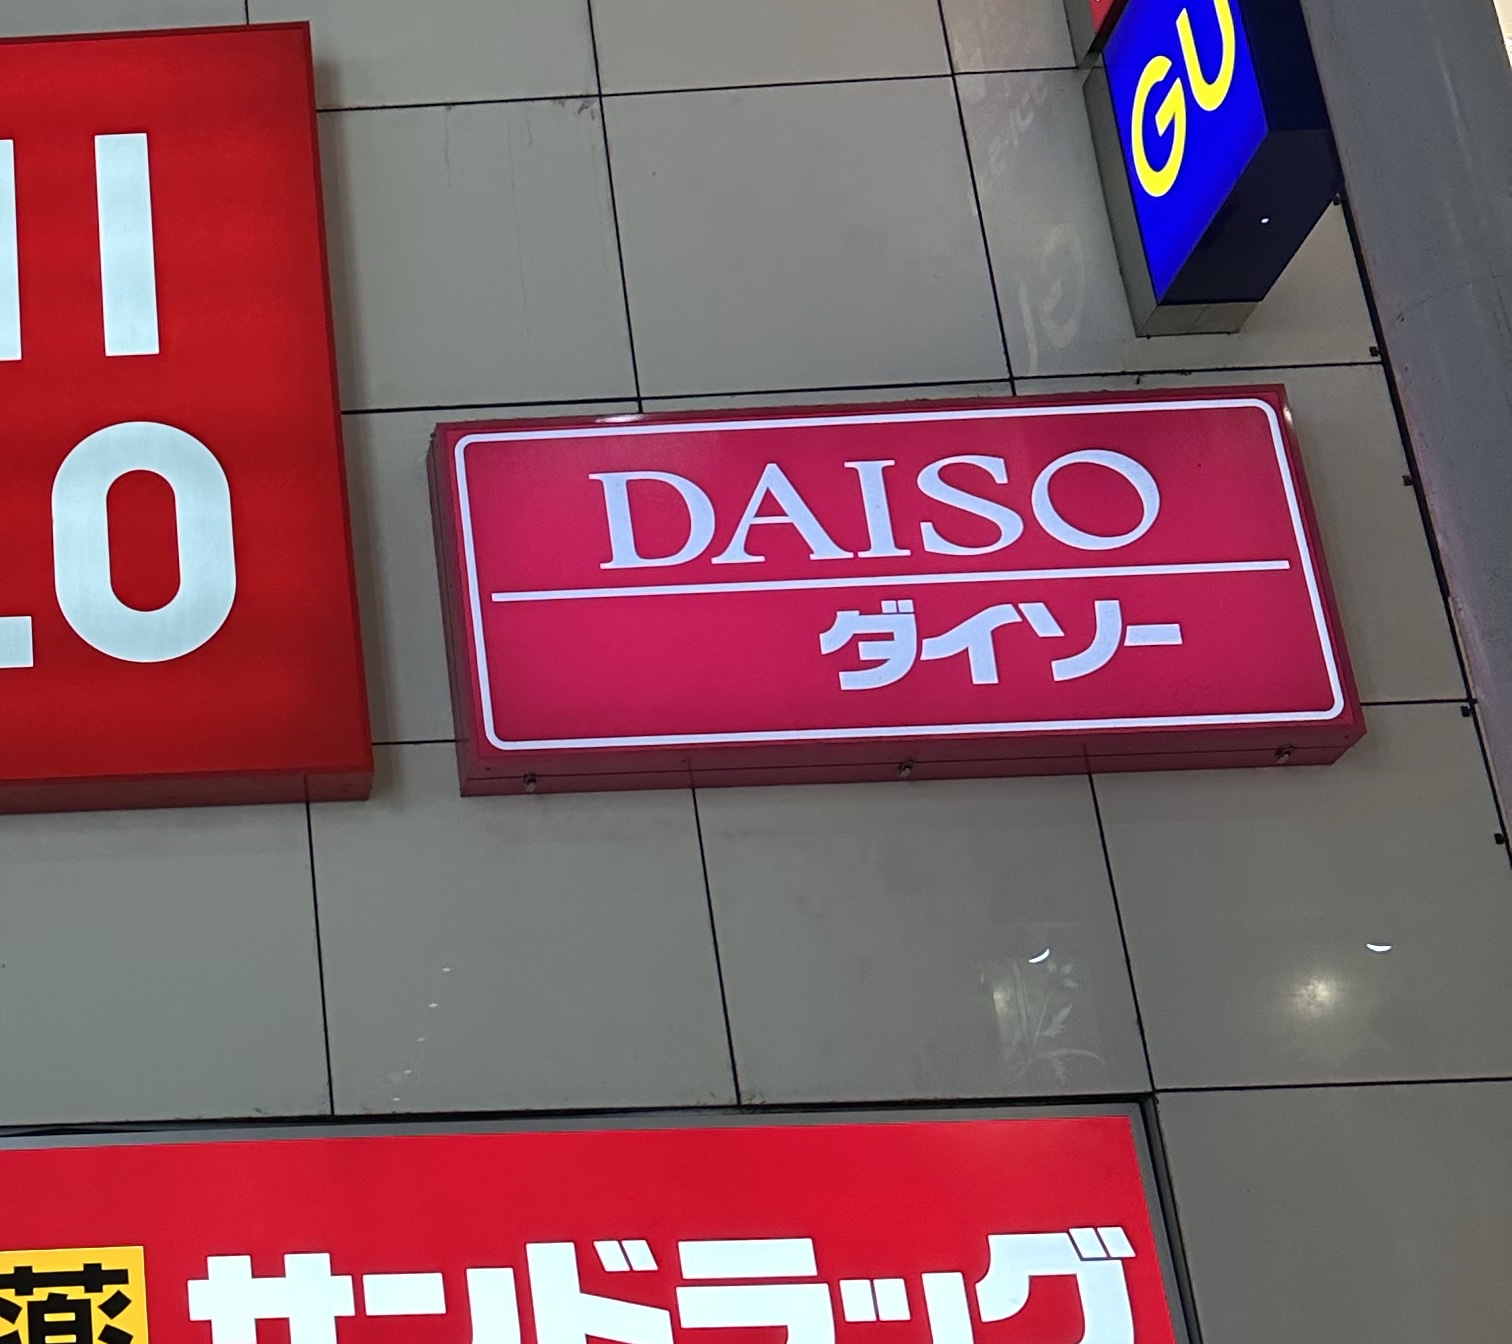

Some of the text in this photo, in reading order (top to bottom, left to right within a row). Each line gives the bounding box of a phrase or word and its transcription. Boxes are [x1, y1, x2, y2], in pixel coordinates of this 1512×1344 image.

[589, 449, 1161, 570] DAISO
[820, 599, 1183, 691] ダイソー
